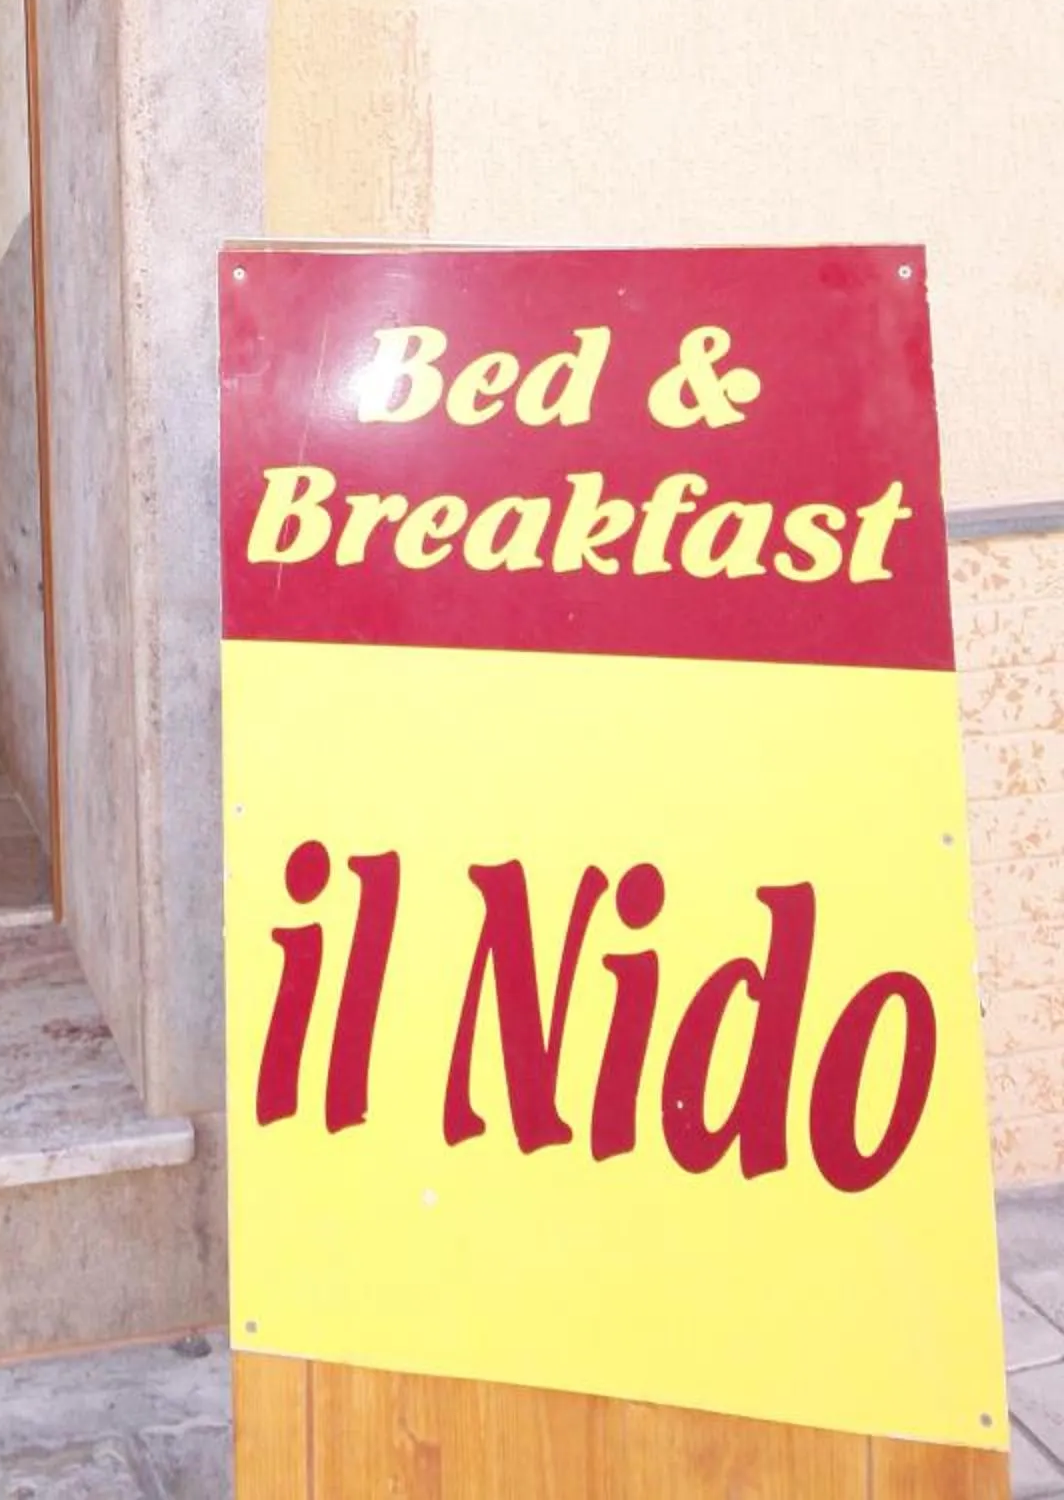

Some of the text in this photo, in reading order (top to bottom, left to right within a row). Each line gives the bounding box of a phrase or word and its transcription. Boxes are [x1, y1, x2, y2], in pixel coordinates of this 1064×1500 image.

[358, 323, 761, 428] Bed &
[245, 465, 913, 583] Breakfast
[255, 839, 937, 1193] il Nido
